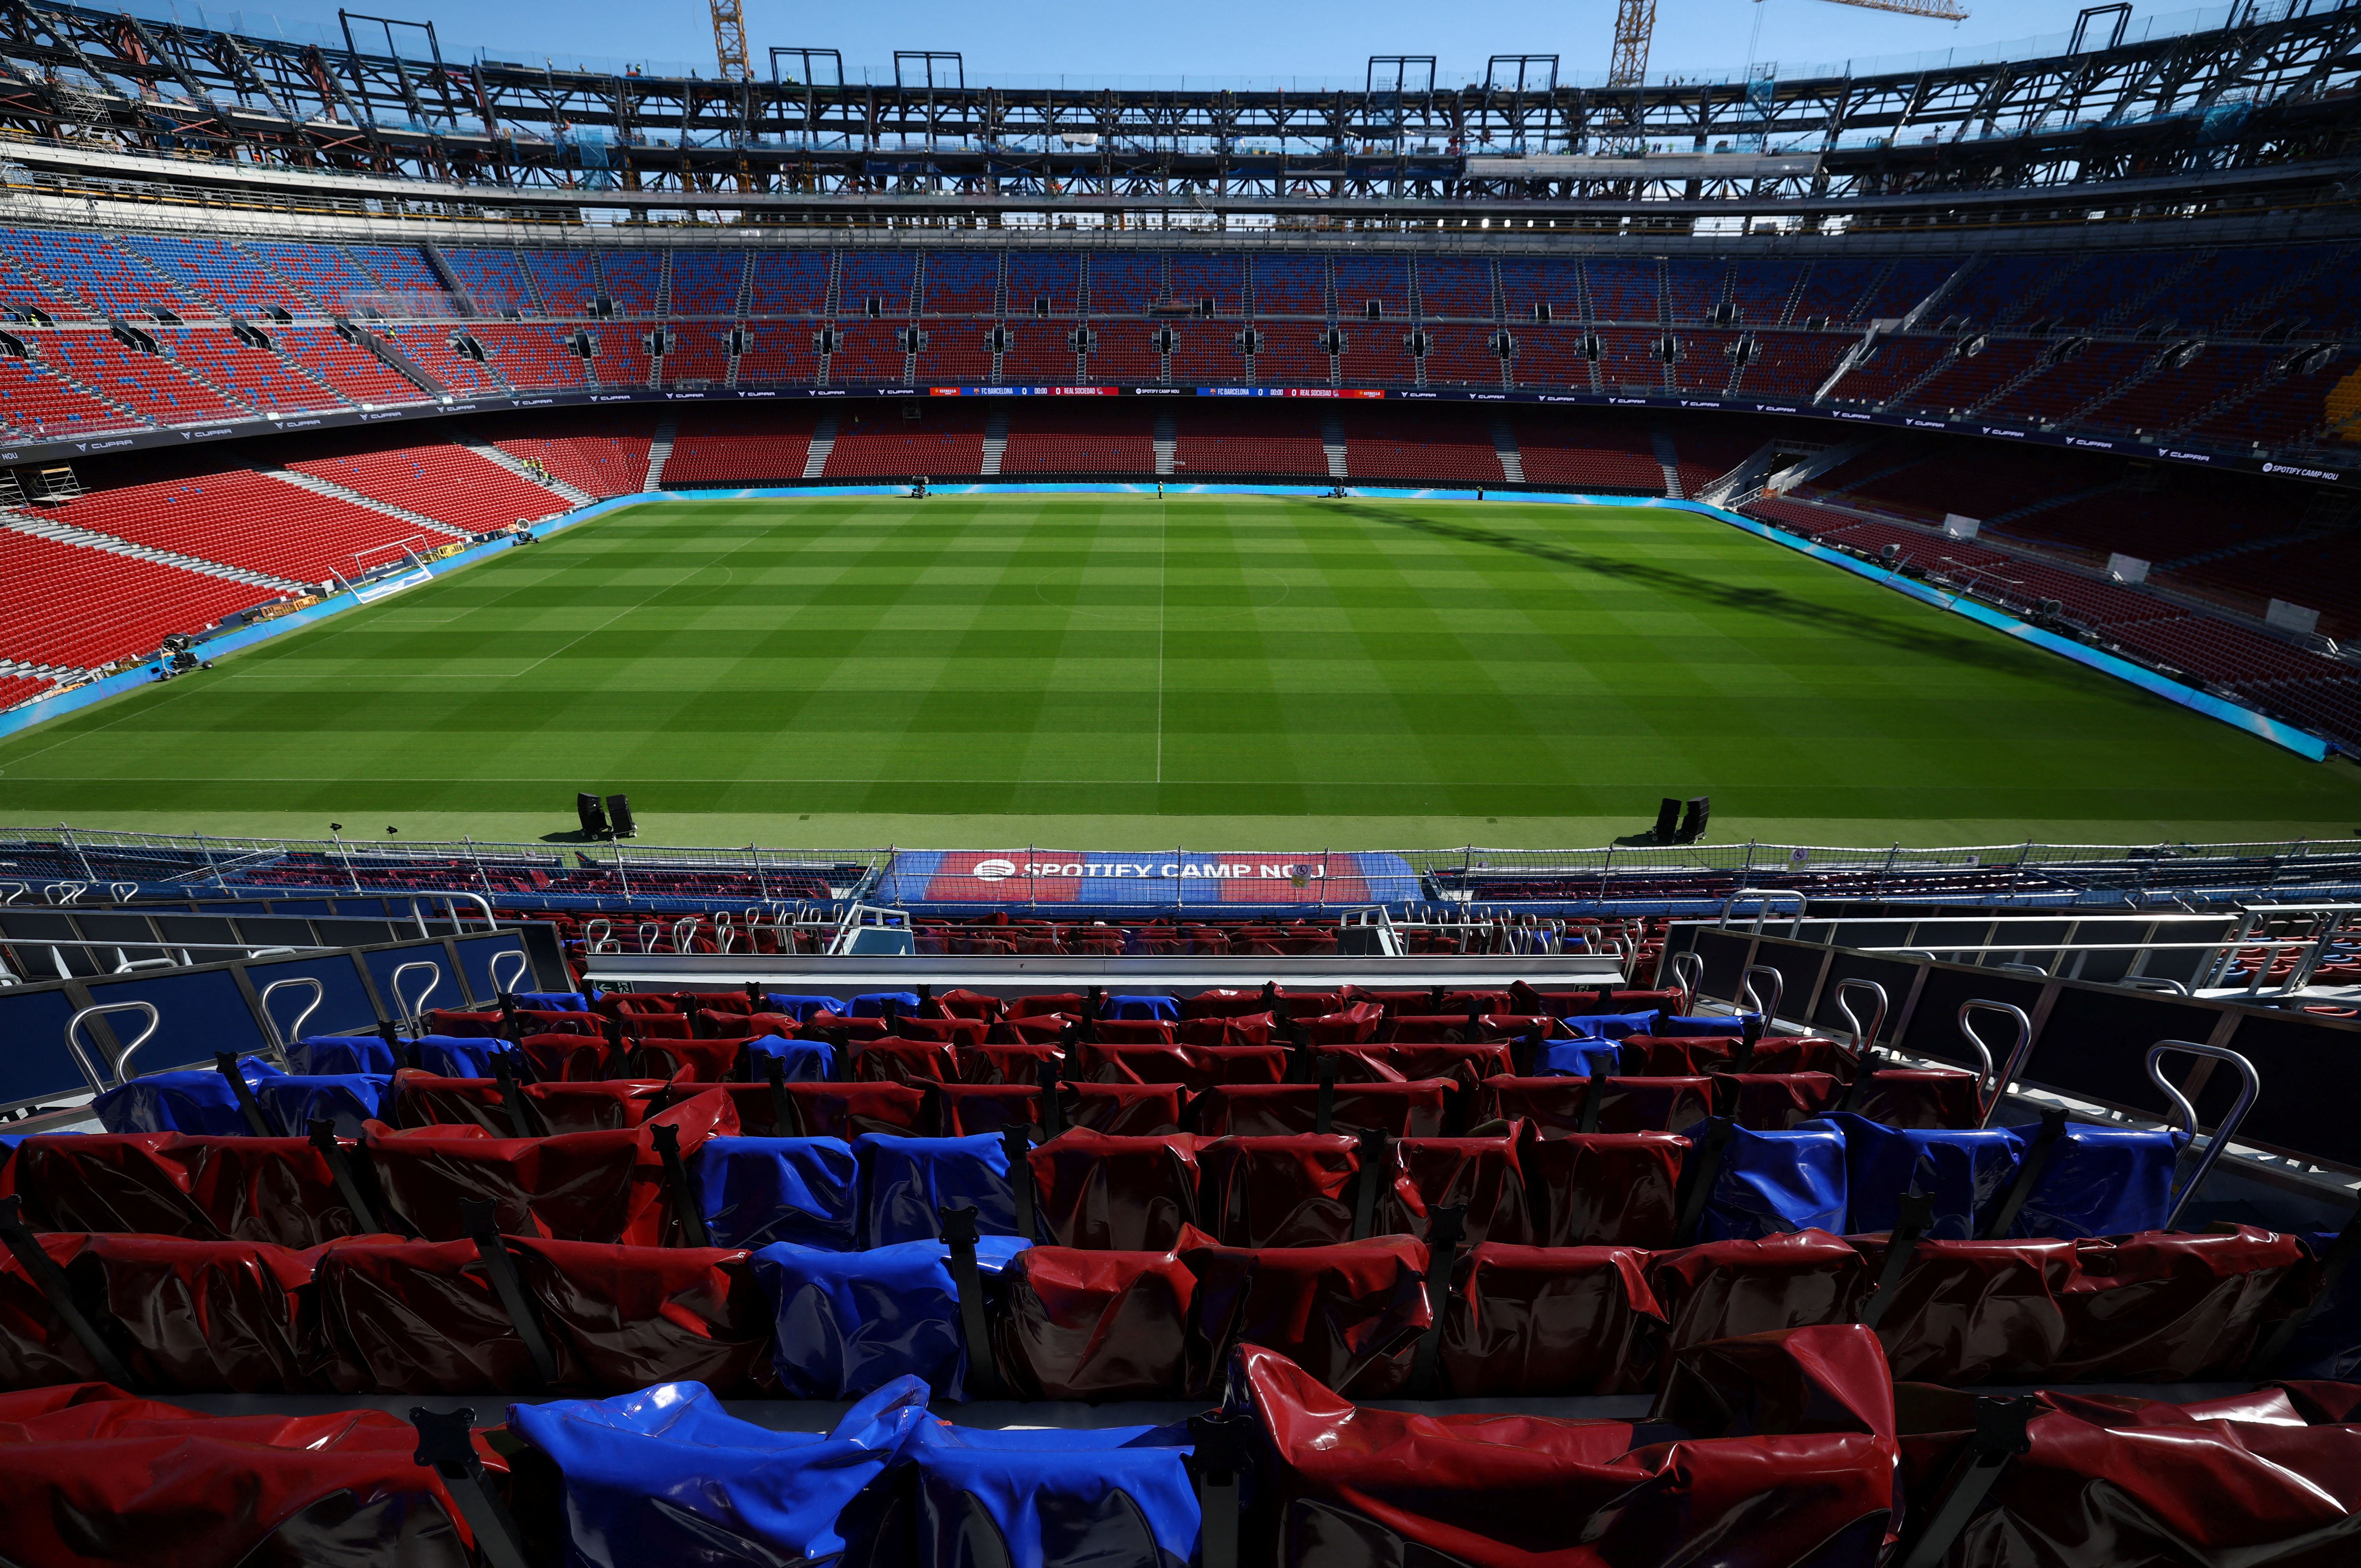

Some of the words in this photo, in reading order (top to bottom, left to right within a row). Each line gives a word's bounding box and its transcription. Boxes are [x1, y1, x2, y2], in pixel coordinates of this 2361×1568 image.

[286, 419, 321, 428] CUPRA
[194, 428, 233, 437] CUPRA
[1992, 429, 2025, 437] CUPRA
[91, 439, 133, 449] CUPRA
[2076, 439, 2112, 448] CUPRA
[2170, 451, 2210, 461] CUPRA
[2272, 466, 2301, 474] SPOTIFY
[2301, 469, 2322, 477] CAMP
[1023, 863, 1153, 877] SPOTIFY
[1161, 864, 1252, 878] CAMP
